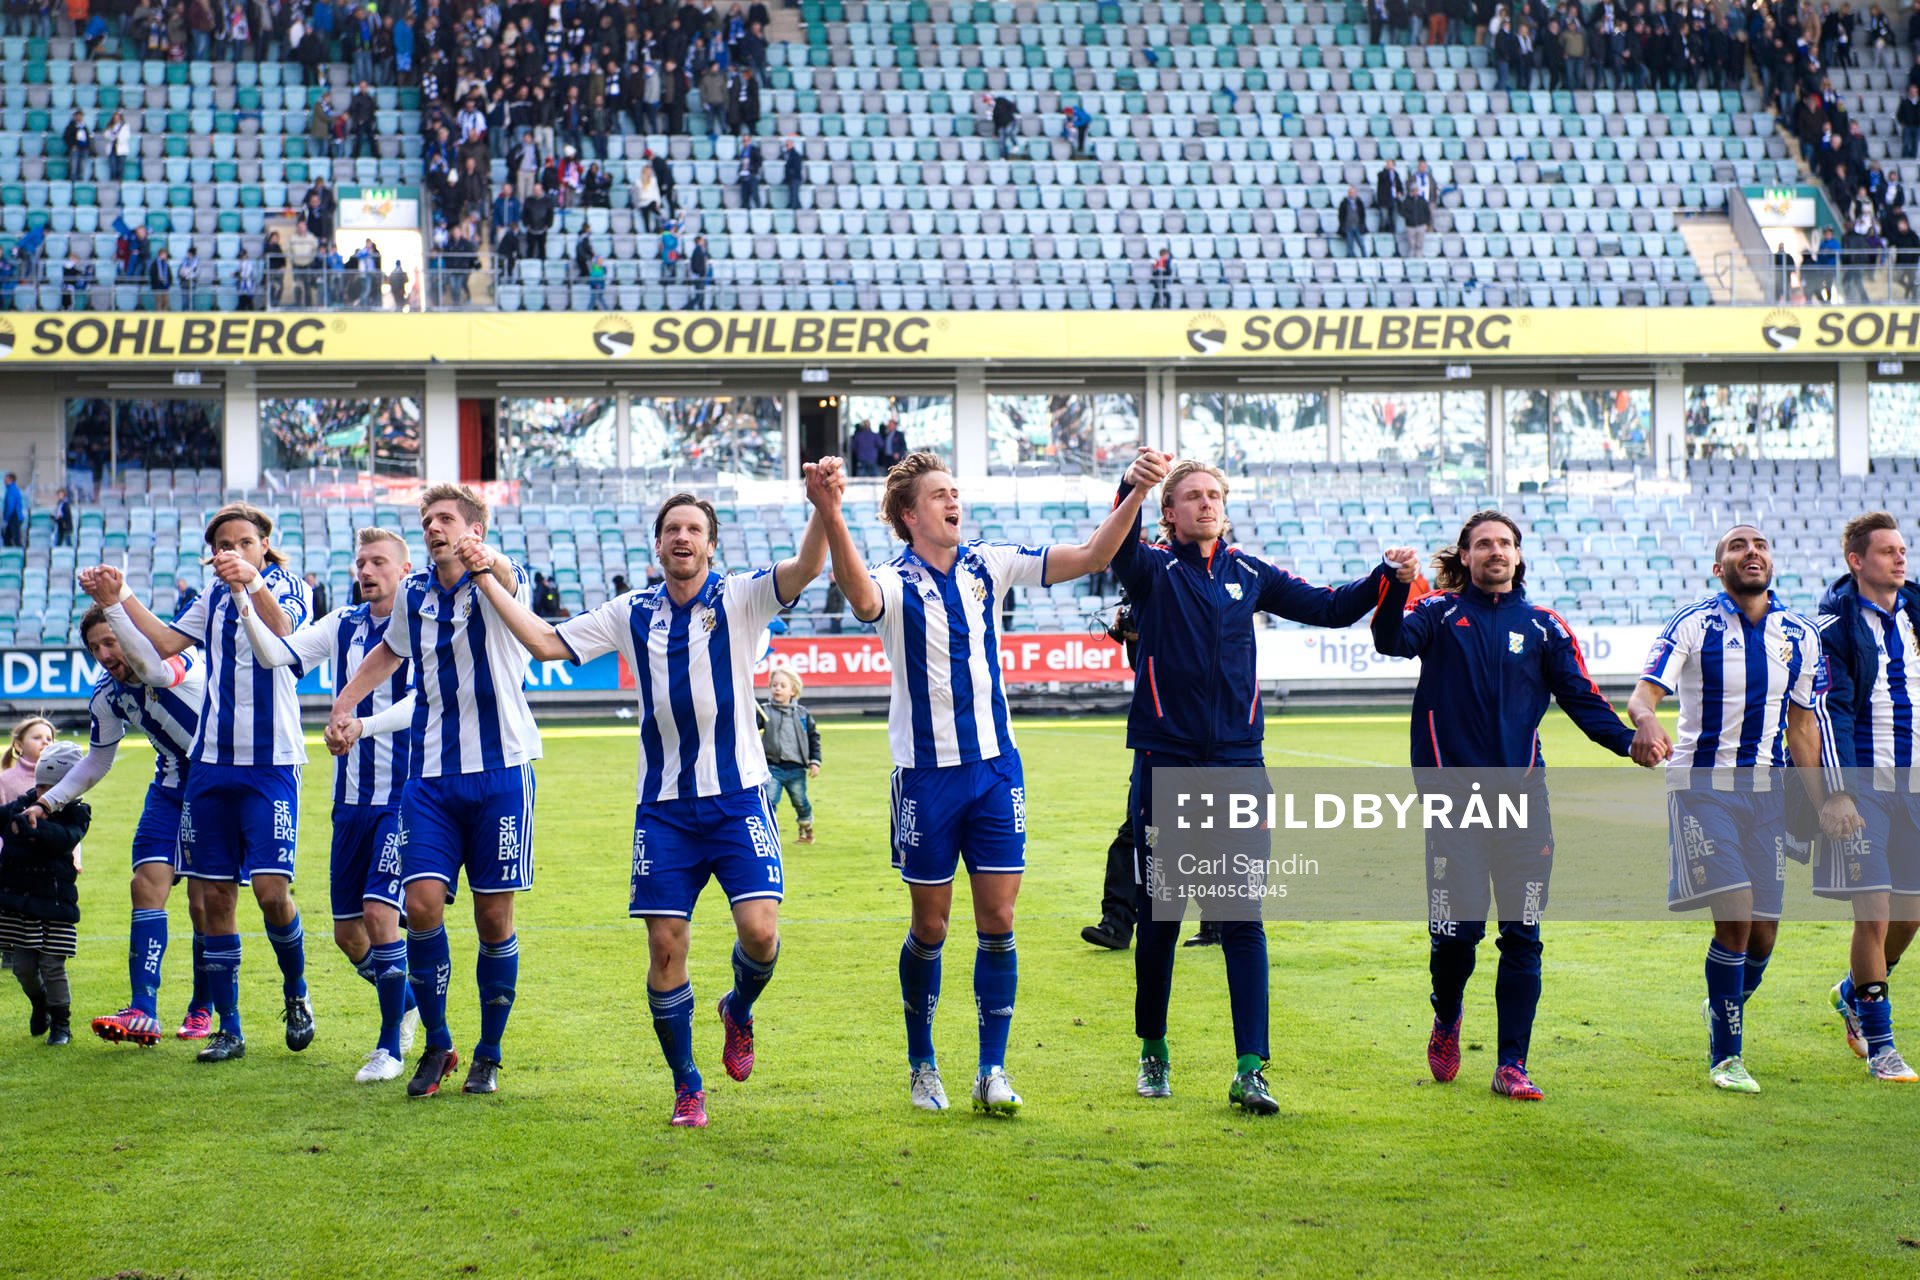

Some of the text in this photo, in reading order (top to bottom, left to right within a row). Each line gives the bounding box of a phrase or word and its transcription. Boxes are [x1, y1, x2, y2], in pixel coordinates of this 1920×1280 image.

[31, 318, 327, 356] SOHLBERG
[650, 317, 931, 354] SOHLBERG
[1241, 314, 1513, 352] SOHLBERG
[1021, 643, 1041, 671] F
[1046, 640, 1116, 671] eller
[274, 800, 290, 814] SE
[902, 798, 917, 815] SE
[274, 813, 292, 828] RN
[499, 816, 516, 832] SE
[901, 812, 916, 830] RN
[1683, 815, 1700, 831] SE
[274, 826, 296, 842] EKE
[499, 829, 518, 846] RN
[900, 827, 920, 847] EKE
[1684, 826, 1705, 846] RN
[498, 844, 521, 861] EKE
[1686, 840, 1715, 861] EKE
[1774, 836, 1784, 852] S
[1843, 839, 1871, 855] EKE
[277, 847, 294, 865] 24
[501, 863, 518, 882] 16
[766, 864, 781, 884] 13
[387, 879, 400, 895] 6
[1525, 881, 1543, 897] SE
[1432, 888, 1449, 905] SE
[1524, 896, 1540, 912] RN
[1430, 903, 1451, 921] RN
[1430, 919, 1457, 937] EKE
[144, 937, 162, 974] SKF
[1725, 999, 1743, 1037] SKF
